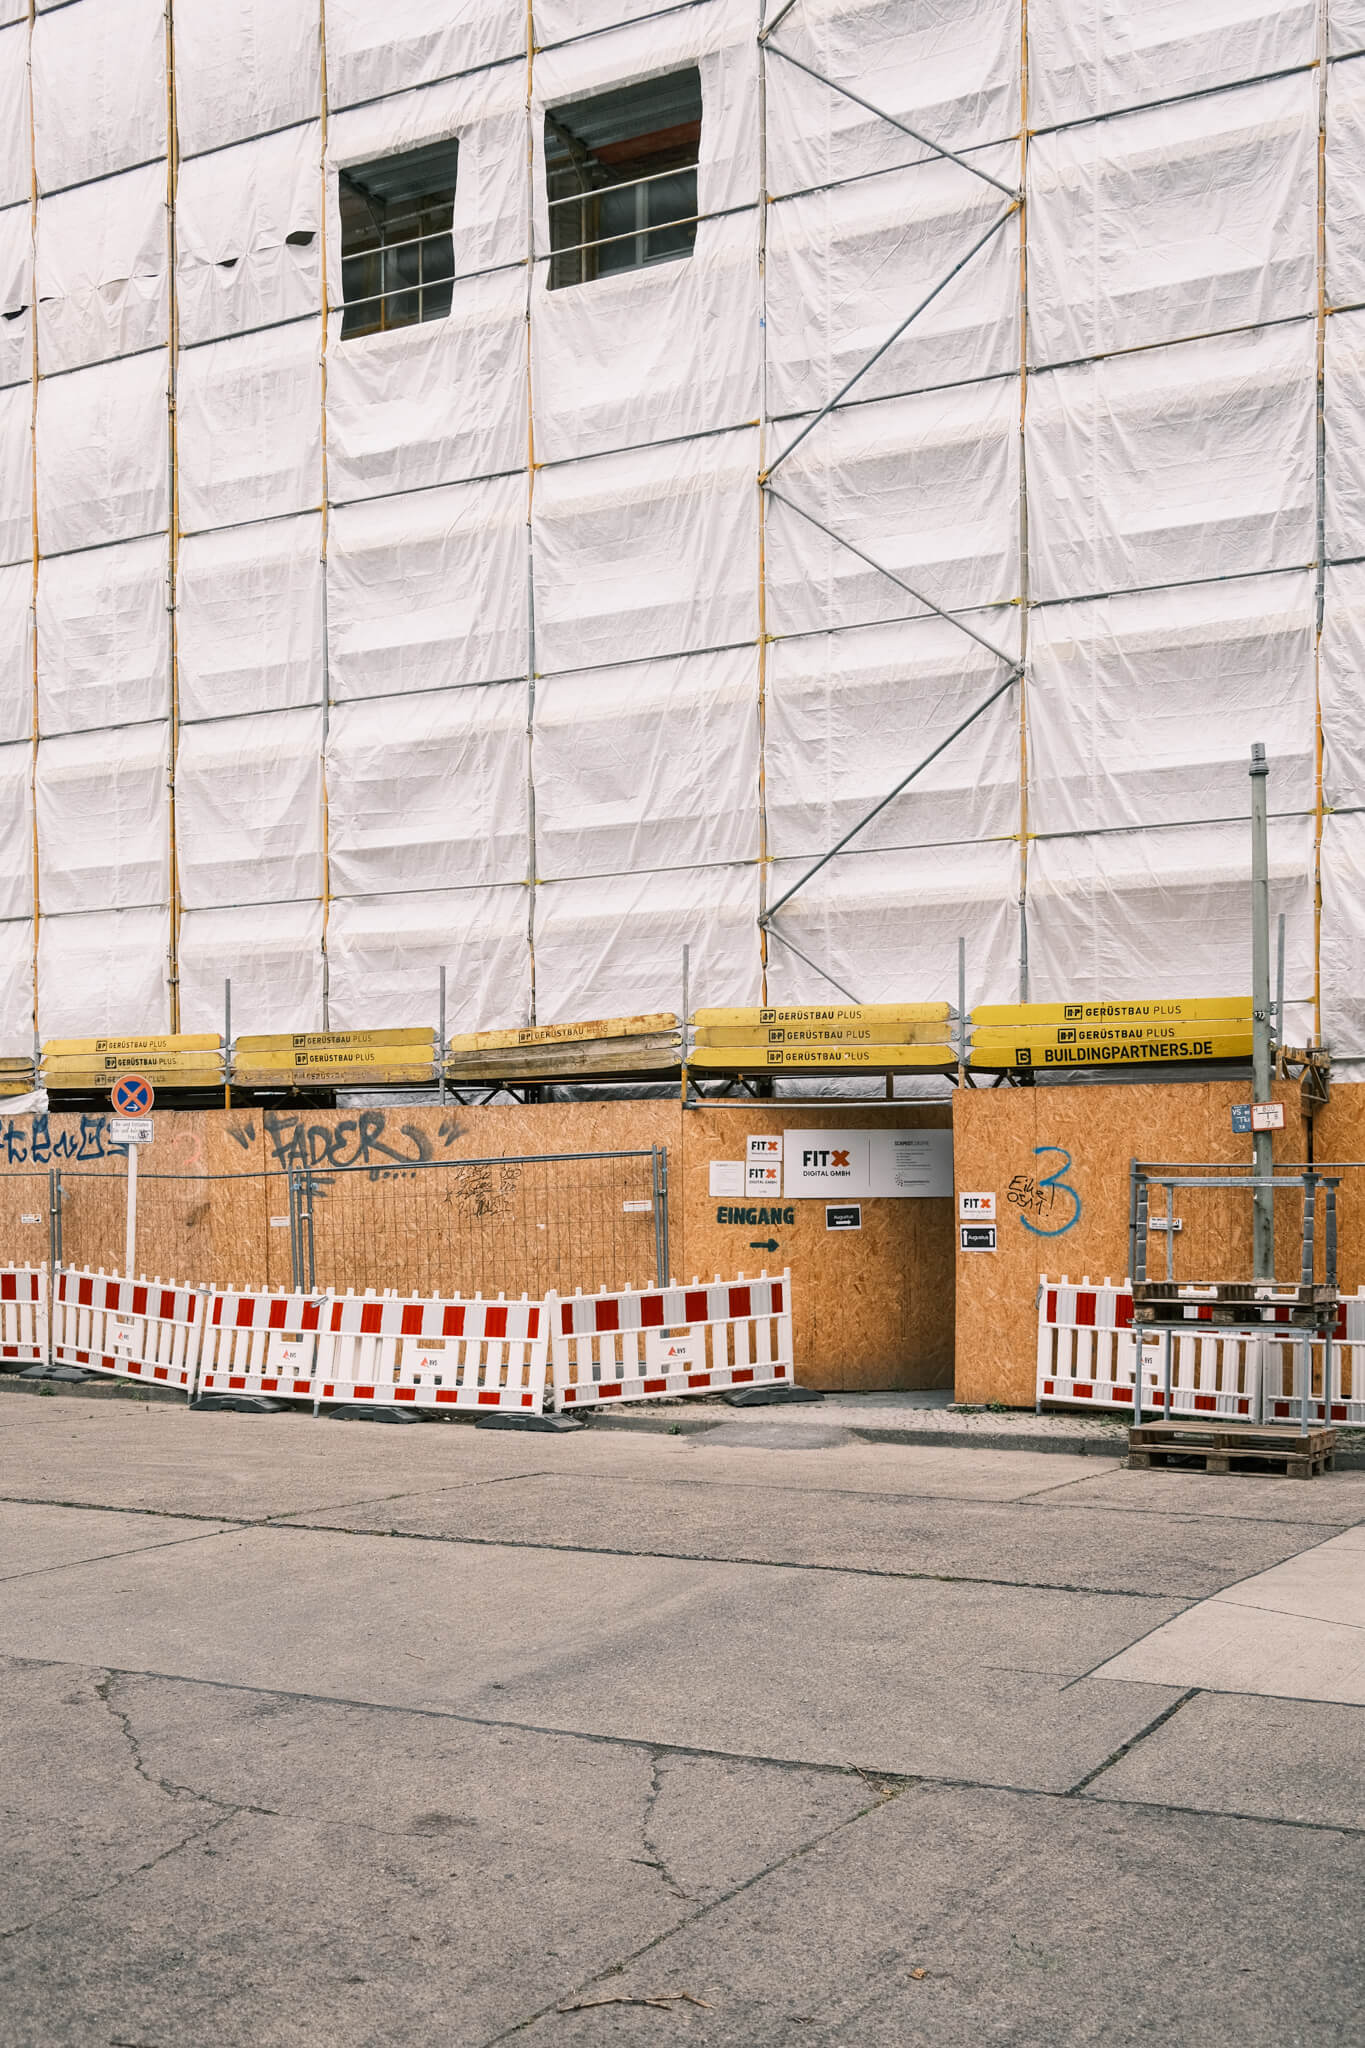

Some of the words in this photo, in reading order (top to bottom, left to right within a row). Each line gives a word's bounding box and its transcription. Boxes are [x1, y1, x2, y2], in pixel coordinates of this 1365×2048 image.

[778, 1010, 834, 1020] GERÜSTBAU
[837, 1010, 862, 1020] PLUS
[1085, 1005, 1150, 1017] GERÜSTBAU
[1153, 1005, 1182, 1015] PLUS
[308, 1035, 351, 1044] GERÜSTBAU
[352, 1034, 372, 1042] PLUS
[787, 1030, 843, 1040] GERÜSTBAU
[846, 1030, 871, 1039] PLUS
[1078, 1028, 1143, 1040] GERÜSTBAU
[1146, 1028, 1176, 1038] PLUS
[108, 1040, 148, 1048] GERÜSTBAU
[149, 1040, 168, 1048] PLUS
[786, 1051, 842, 1061] GERÜSTBAU
[844, 1052, 870, 1060] PLUS
[1044, 1041, 1213, 1062] BUILDINGPARTNERS.DE
[118, 1057, 157, 1066] GERÜSTBAU
[158, 1057, 177, 1065] PLUS
[310, 1053, 352, 1062] GERÜSTBAU
[752, 1141, 778, 1151] FITX
[802, 1150, 850, 1167] FITX
[749, 1168, 776, 1178] FITX
[1020, 1146, 1081, 1237] 3
[964, 1198, 992, 1209] FITX
[716, 1206, 795, 1225] EINGANG
